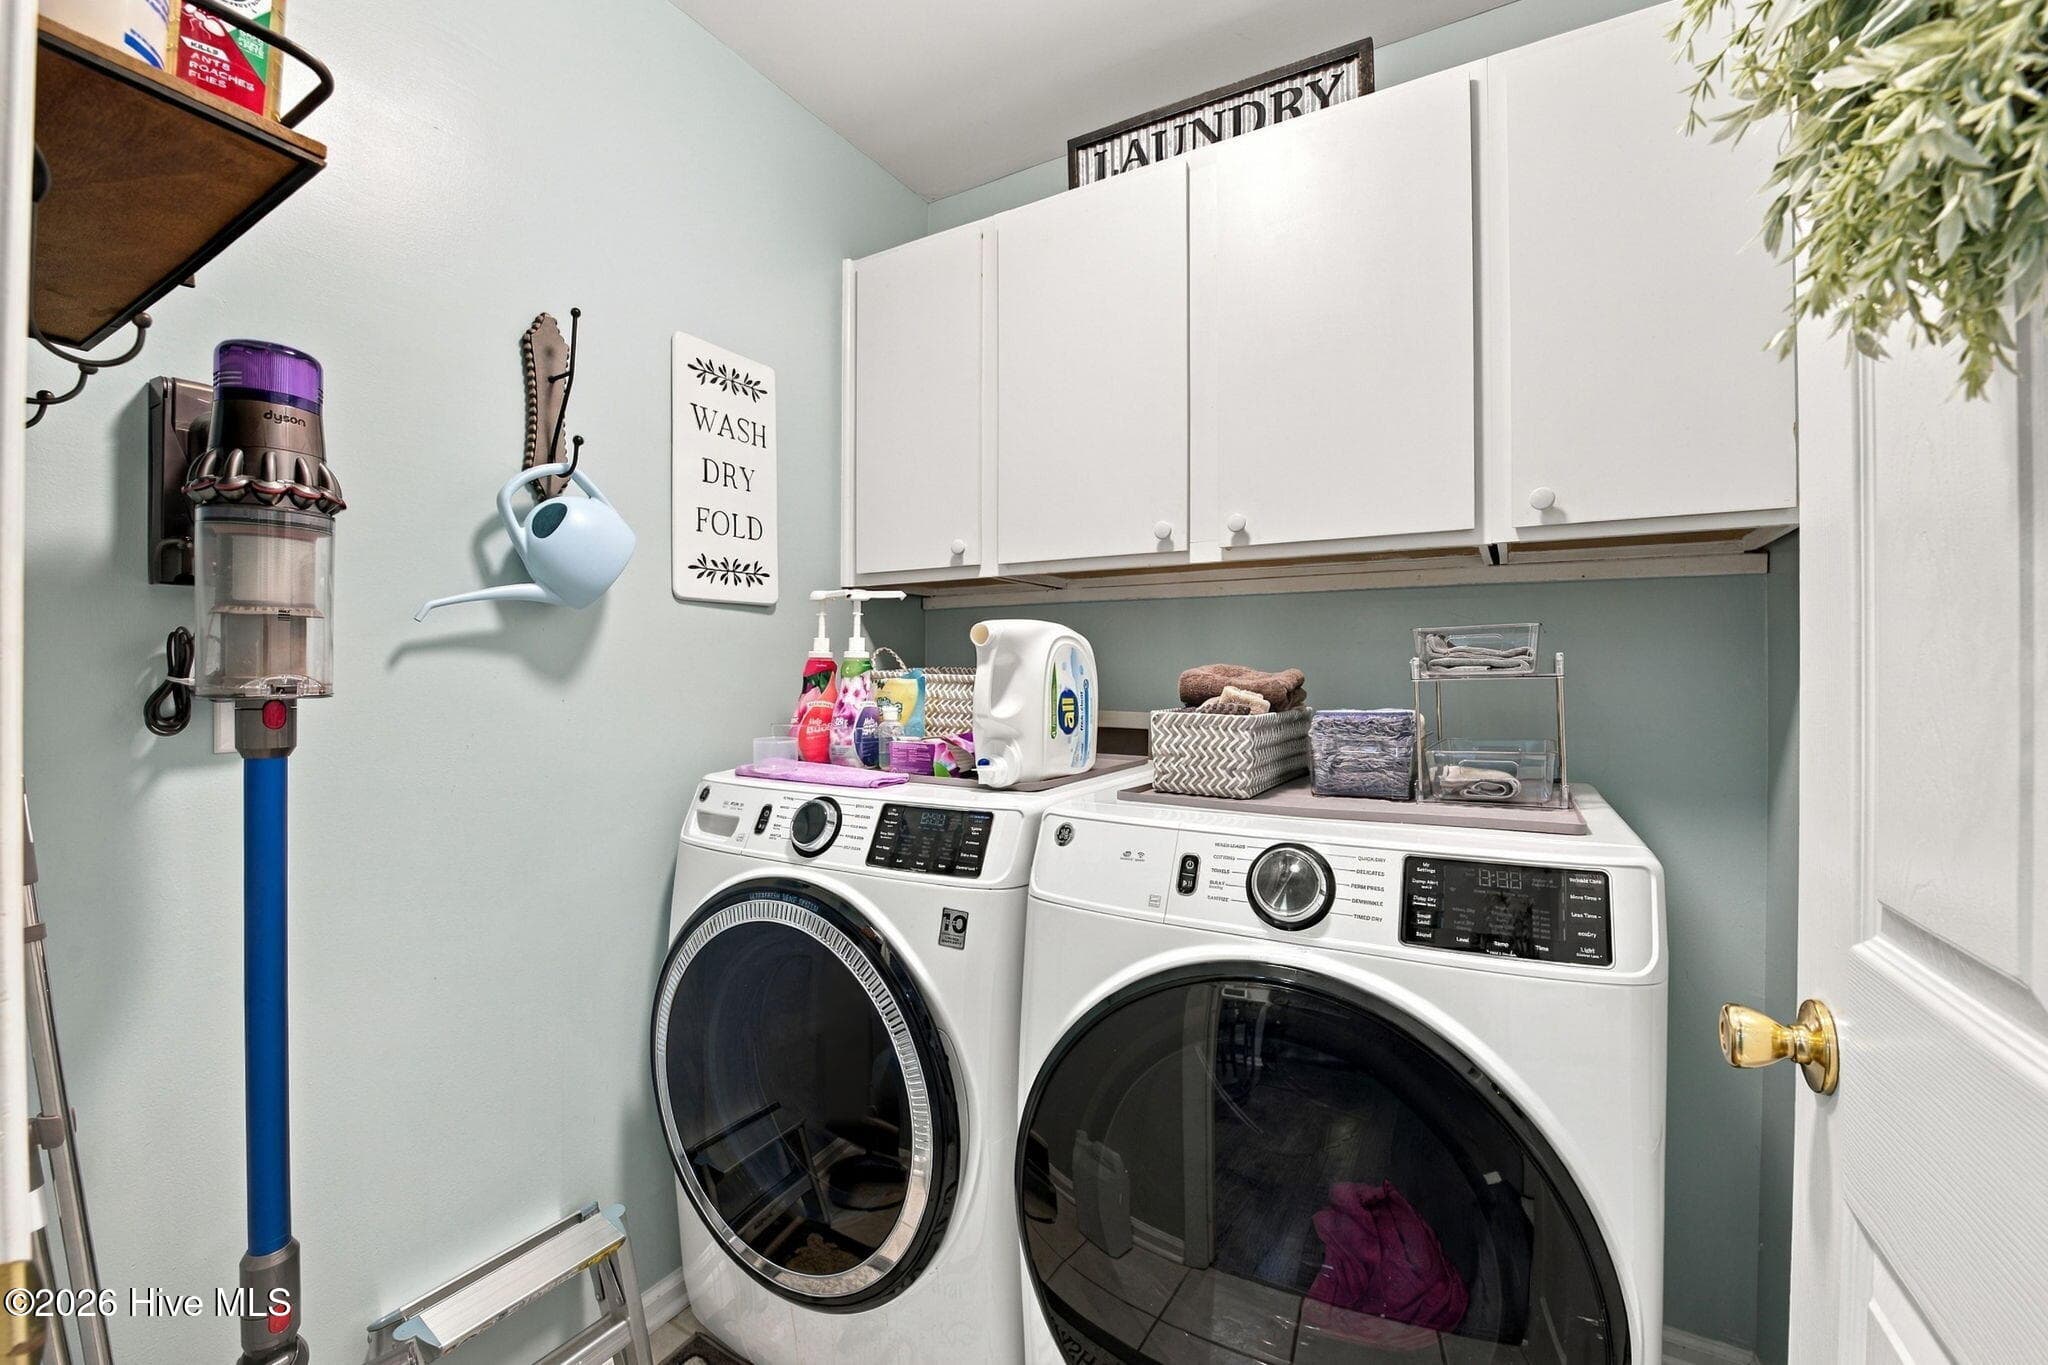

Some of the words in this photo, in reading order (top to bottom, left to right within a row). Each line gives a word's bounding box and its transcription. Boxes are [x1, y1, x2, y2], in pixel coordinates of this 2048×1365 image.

[190, 41, 219, 55] KILLS
[190, 52, 231, 72] ANTS
[188, 69, 227, 88] FLIES
[189, 60, 255, 91] ROACHES
[1094, 70, 1345, 182] LAUNDRY
[263, 409, 306, 427] dyson
[690, 402, 767, 448] WASH
[702, 457, 755, 492] DRY
[696, 506, 763, 541] FOLD
[1062, 697, 1075, 729] all
[1356, 868, 1385, 877] DELICATES
